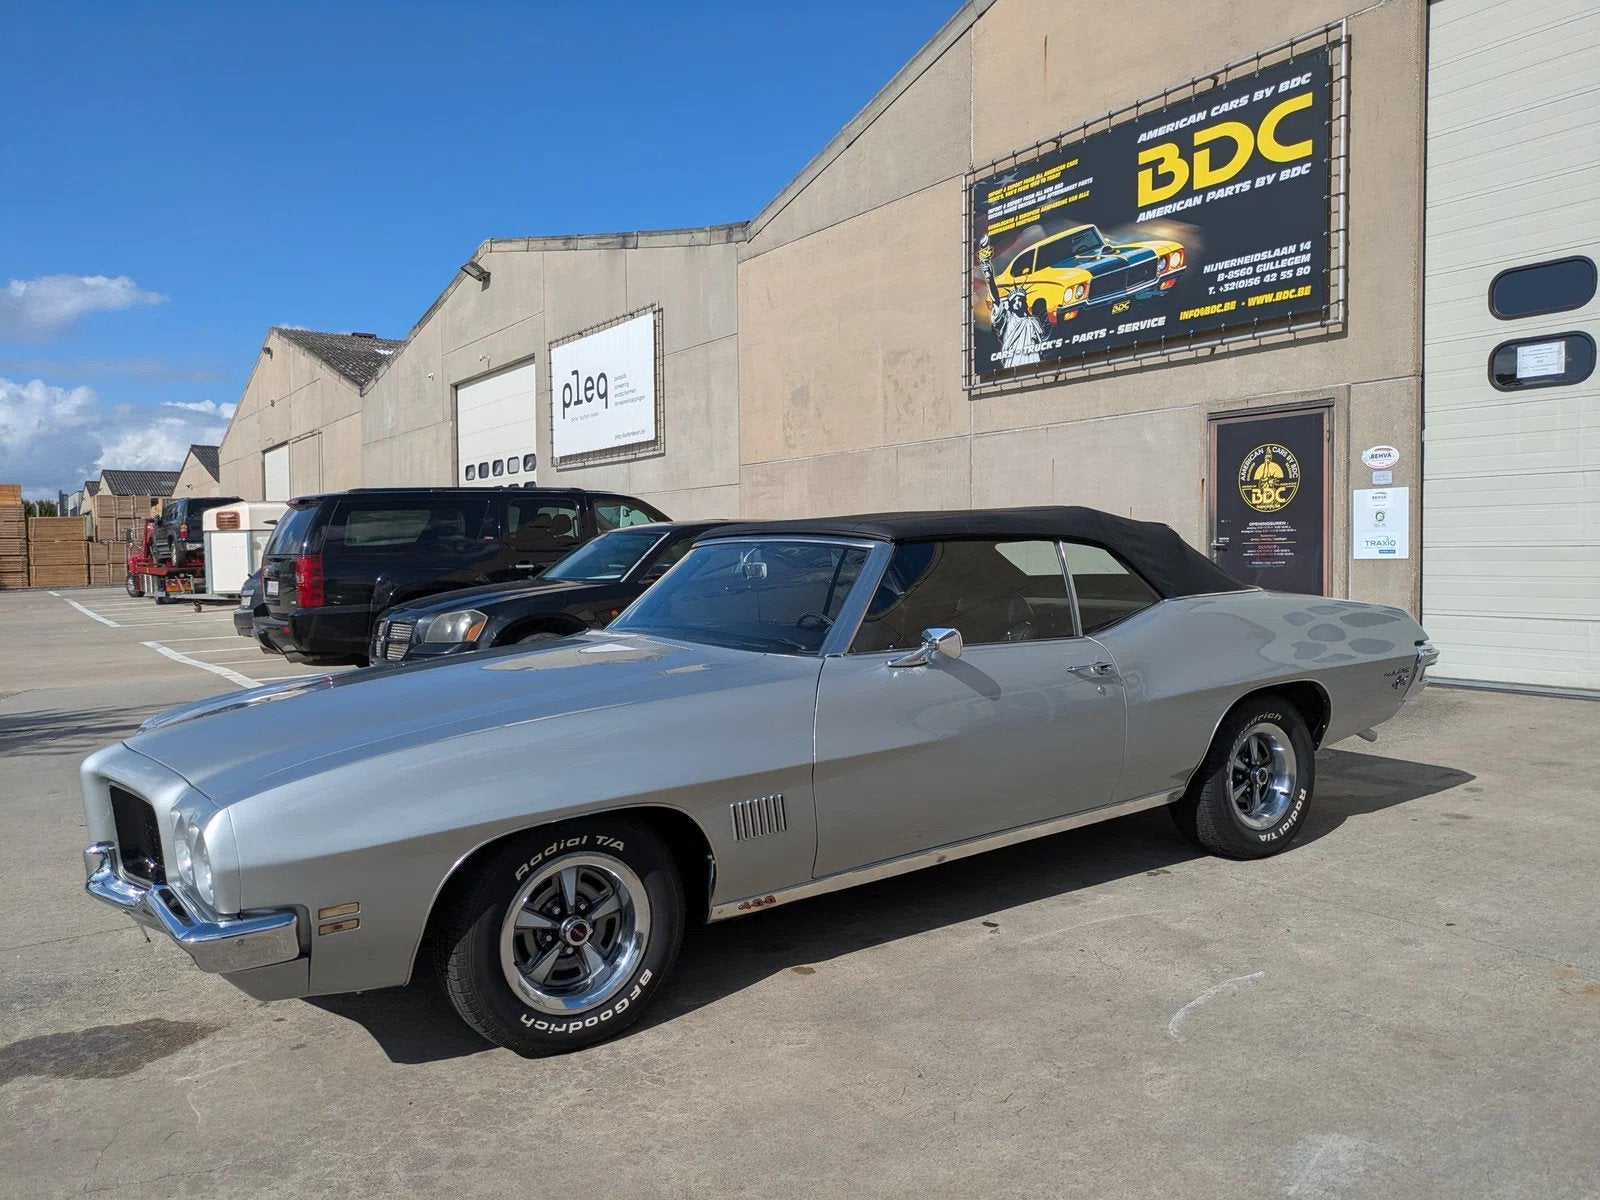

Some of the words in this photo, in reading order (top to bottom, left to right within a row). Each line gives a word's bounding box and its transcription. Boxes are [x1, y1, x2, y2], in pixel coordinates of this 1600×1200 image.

[1137, 110, 1207, 143] AMERICAN
[1210, 94, 1250, 116] CARS
[1252, 85, 1275, 102] BY
[1277, 72, 1312, 93] BDC
[1137, 92, 1313, 208] BDC
[1078, 177, 1093, 187] PARTS
[1136, 195, 1202, 223] AMERICAN
[1206, 180, 1252, 203] PARTS
[1254, 173, 1276, 189] BY
[1279, 163, 1312, 181] BDC
[1203, 244, 1296, 274] NIJVERHEIDSLAAN
[1299, 241, 1312, 252] 14
[1208, 286, 1216, 295] T.
[1218, 276, 1261, 292] +32(0)56
[1263, 272, 1278, 283] 42
[1280, 269, 1294, 280] 55
[1295, 265, 1311, 277] 80
[1217, 266, 1253, 282] B-8560
[1255, 253, 1312, 274] GULLEGEM
[1180, 300, 1237, 320] INFO@BDC.BE
[1248, 286, 1312, 307] WWW.BDC.BE
[990, 350, 1014, 362] CARS
[1023, 338, 1063, 354] TRUCK'S
[1072, 328, 1107, 346] PARTS
[1117, 316, 1166, 335] SERVICE
[562, 369, 608, 419] pleq
[1240, 447, 1264, 481] AMERICAN
[1272, 446, 1288, 458] CARS
[1285, 455, 1294, 464] BY
[1290, 463, 1299, 479] BDC
[1252, 487, 1286, 504] BDC
[1278, 788, 1307, 835] Radial
[514, 835, 589, 882] Radial
[595, 835, 626, 852] T/A
[520, 968, 653, 1034] BFGoodrich
